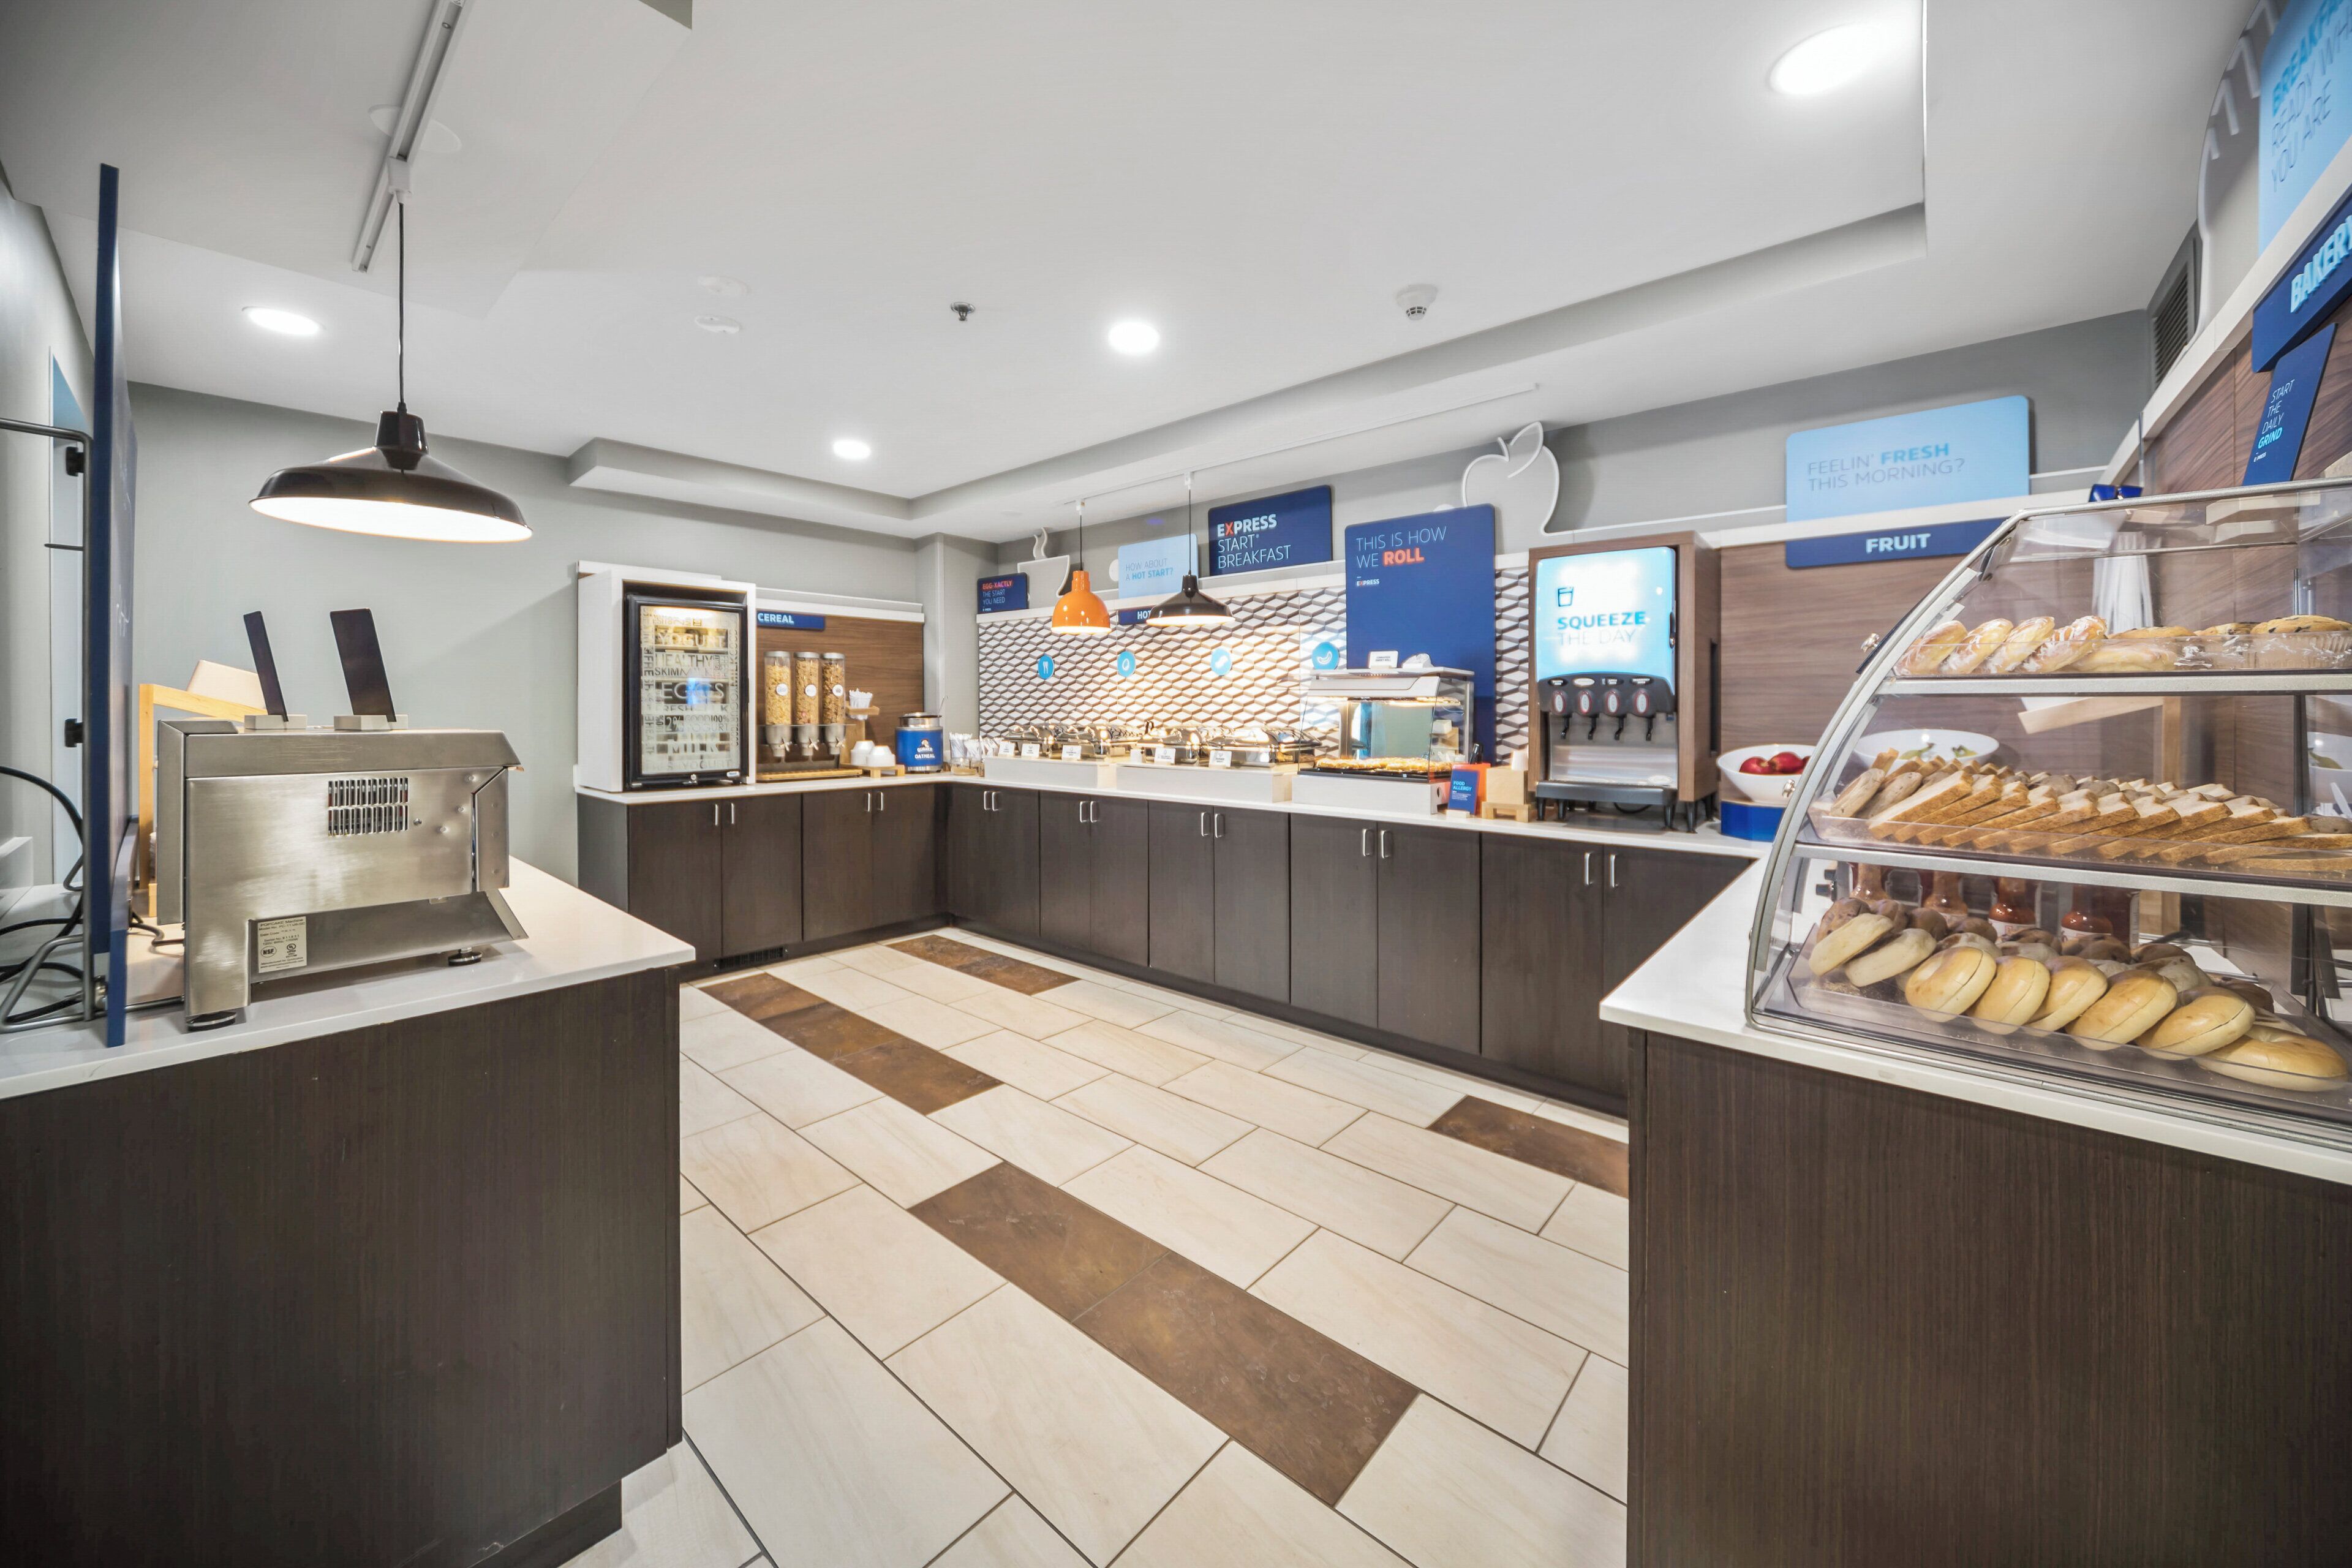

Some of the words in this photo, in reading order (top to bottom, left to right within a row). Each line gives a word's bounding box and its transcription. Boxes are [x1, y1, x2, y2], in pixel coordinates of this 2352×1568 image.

[2272, 130, 2298, 192] YOU
[2302, 78, 2331, 151] ARE
[2271, 379, 2295, 404] START
[2267, 400, 2282, 418] THE
[2262, 412, 2285, 434] DAILY
[2258, 427, 2282, 449] GRIND
[1880, 443, 1950, 464] FRESH
[1808, 474, 1848, 491] THIS
[1855, 458, 1965, 485] MORNING?
[1217, 513, 1277, 537] EXPRESS
[1356, 534, 1386, 551] THIS
[1391, 532, 1403, 547] IS
[1409, 526, 1447, 545] HOW
[1866, 533, 1931, 553] FRUIT
[1126, 563, 1142, 571] HOW
[1144, 558, 1168, 568] ABOUT
[1218, 545, 1291, 569] BREAKFAST
[1357, 553, 1379, 568] WE
[1383, 548, 1425, 566] ROLL
[1148, 568, 1174, 579] START?
[757, 612, 794, 624] CEREAL
[1557, 611, 1646, 630] SQUEEZE
[1558, 630, 1593, 646] THE
[1599, 629, 1637, 645] DAY
